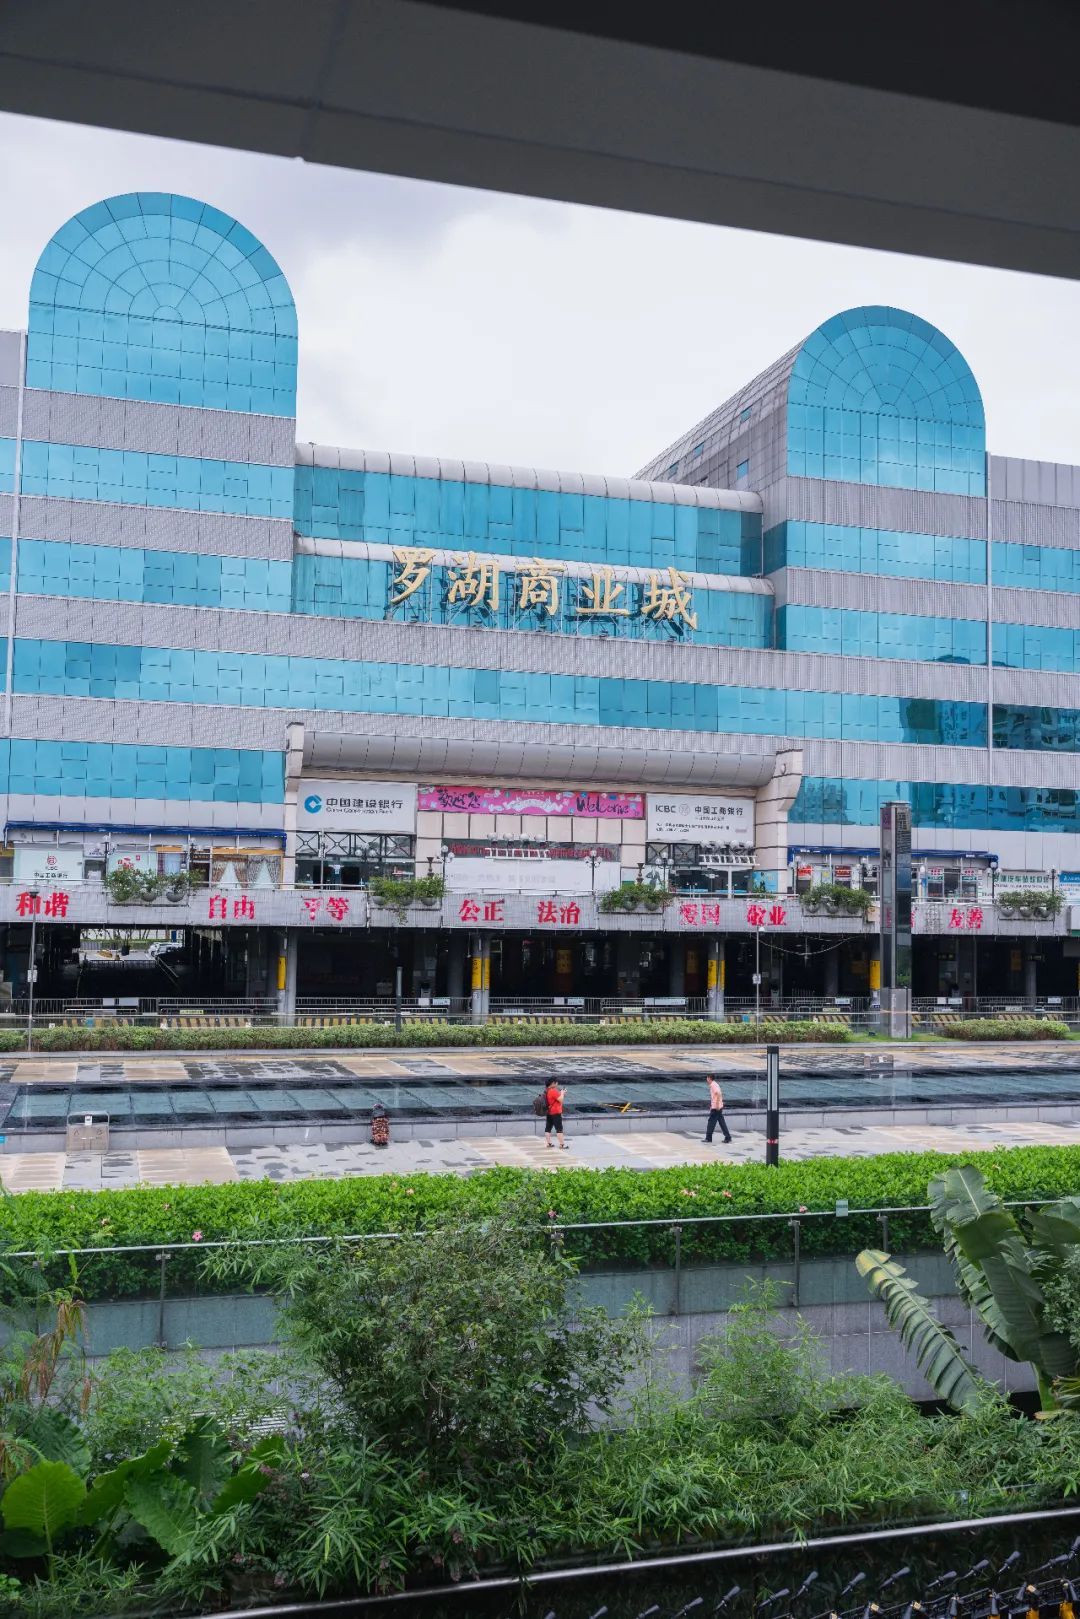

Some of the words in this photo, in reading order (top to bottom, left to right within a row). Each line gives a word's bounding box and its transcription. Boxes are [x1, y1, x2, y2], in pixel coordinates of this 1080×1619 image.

[390, 547, 698, 631] 罗湖商业城
[326, 797, 404, 809] 中国建设银行
[576, 796, 629, 815] Welcome
[655, 804, 677, 814] ICBC
[694, 805, 744, 816] 中国工商银行
[16, 892, 70, 918] 和谐
[208, 894, 256, 920] 自由
[301, 896, 350, 921] 平等
[459, 898, 505, 923] 公正
[537, 901, 580, 924] 法治
[679, 903, 721, 926] 爱国
[747, 904, 787, 926] 敬业
